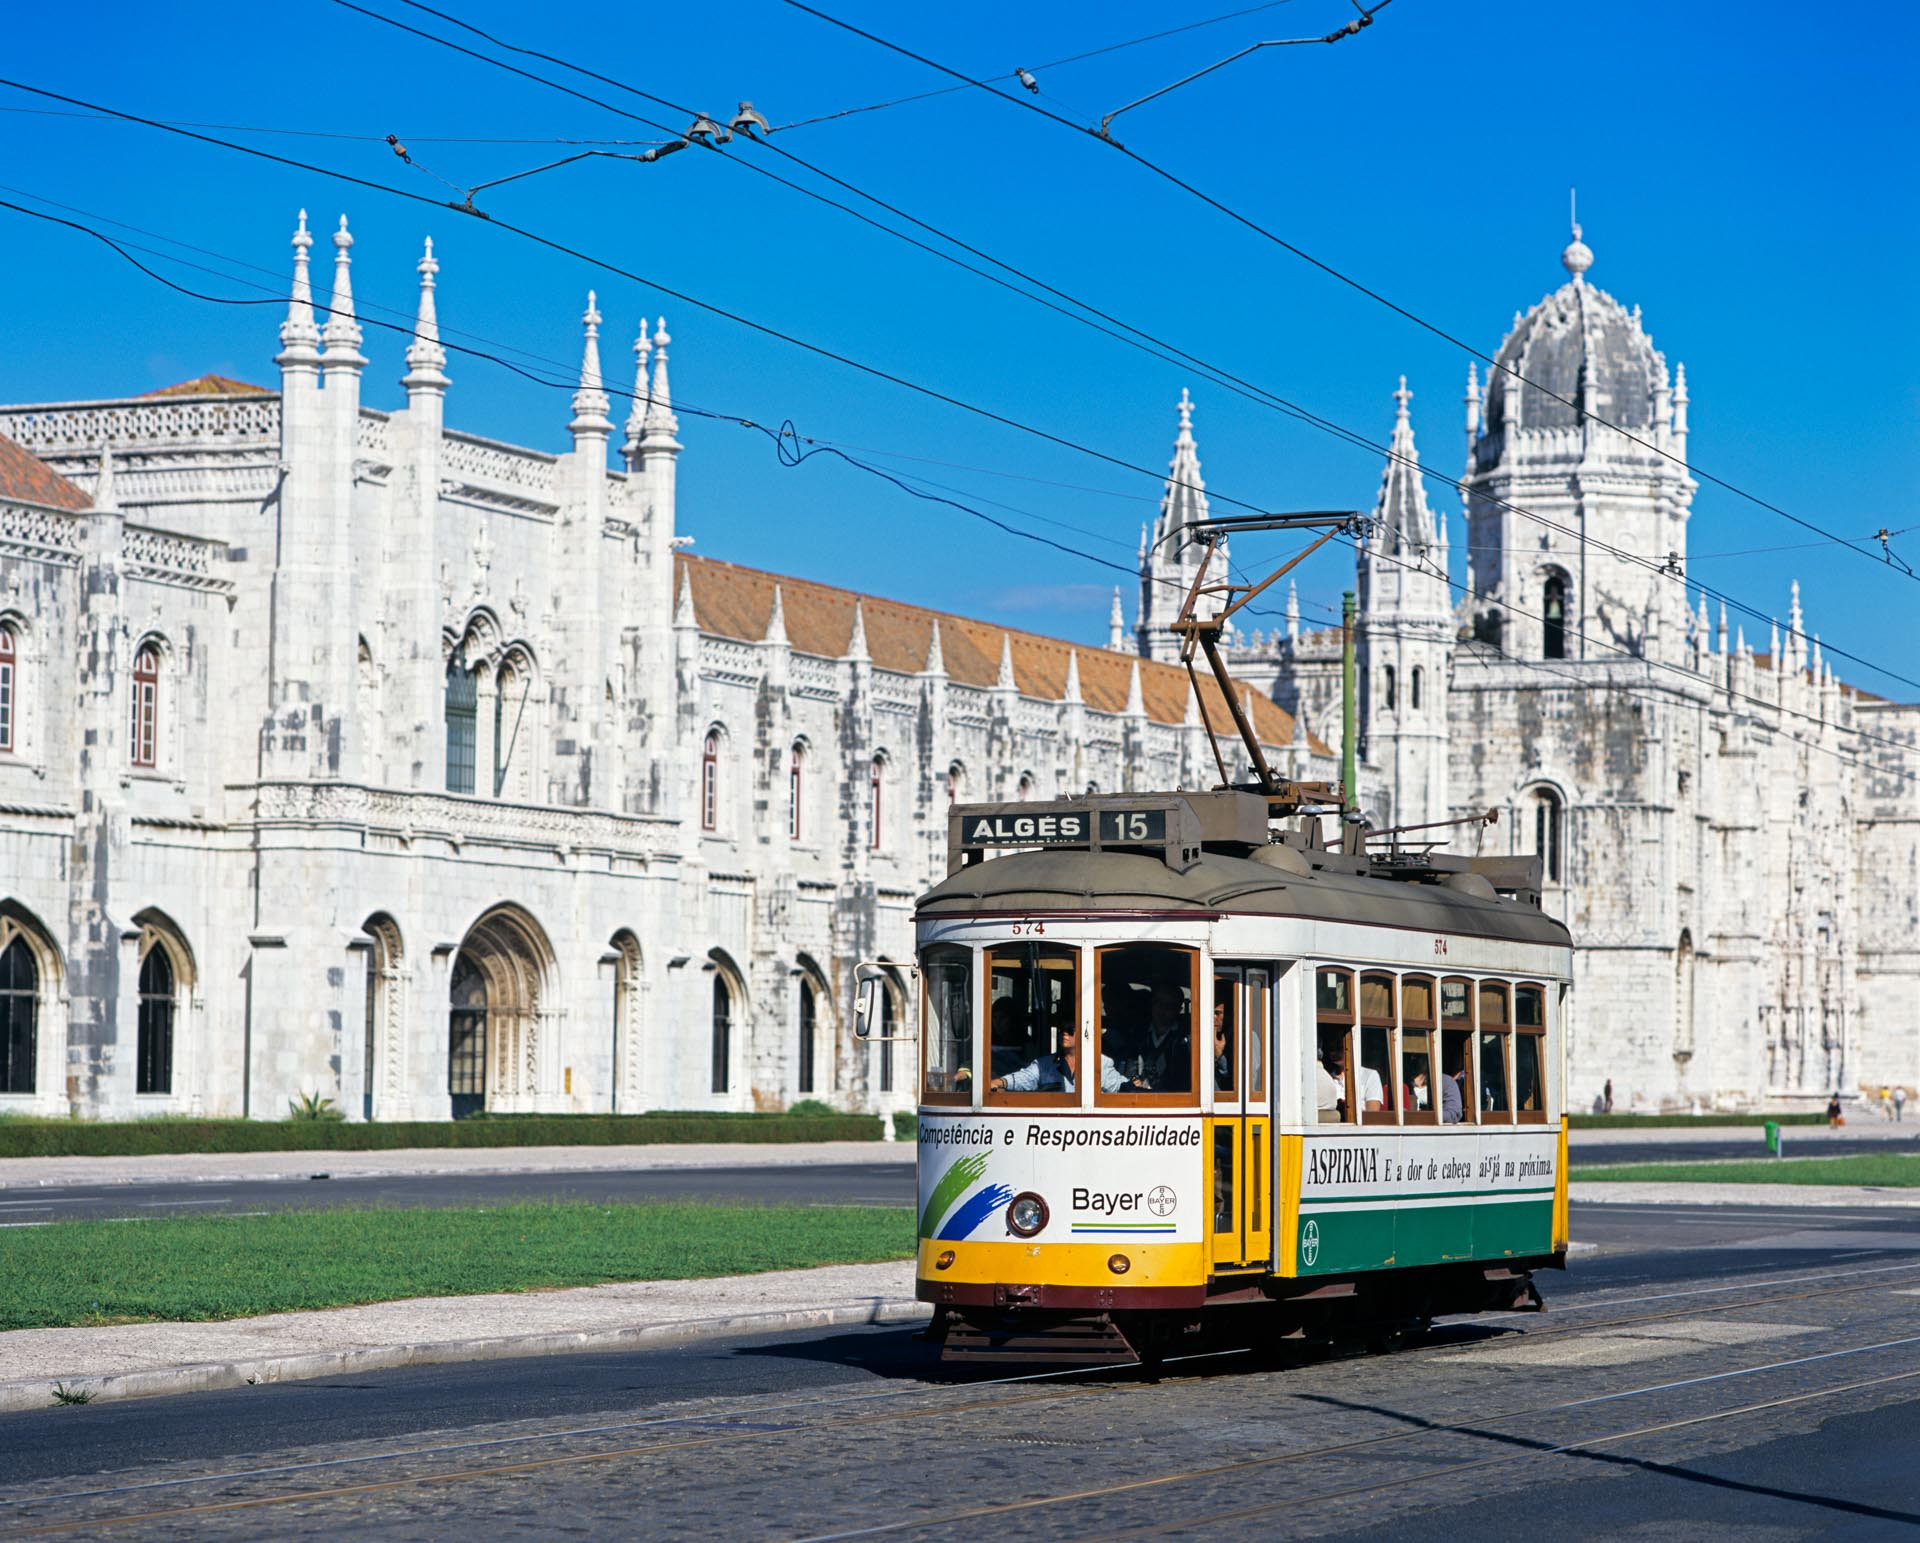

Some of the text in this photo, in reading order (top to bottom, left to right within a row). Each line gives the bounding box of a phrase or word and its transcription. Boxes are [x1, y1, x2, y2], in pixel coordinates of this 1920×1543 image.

[972, 813, 1148, 840] ALGÉS 15
[1012, 920, 1046, 935] 574
[1434, 939, 1448, 956] 574
[919, 1123, 1201, 1152] Competência e Responsabilidade
[1384, 1159, 1393, 1182] E
[1396, 1165, 1402, 1182] a
[1407, 1158, 1423, 1181] dor
[1427, 1158, 1438, 1180] de
[1441, 1157, 1471, 1184] cabeça
[1504, 1161, 1515, 1177] na
[1518, 1153, 1553, 1182] próxima.
[1072, 1188, 1143, 1216] Bayer
[1149, 1197, 1175, 1205] BAYER
